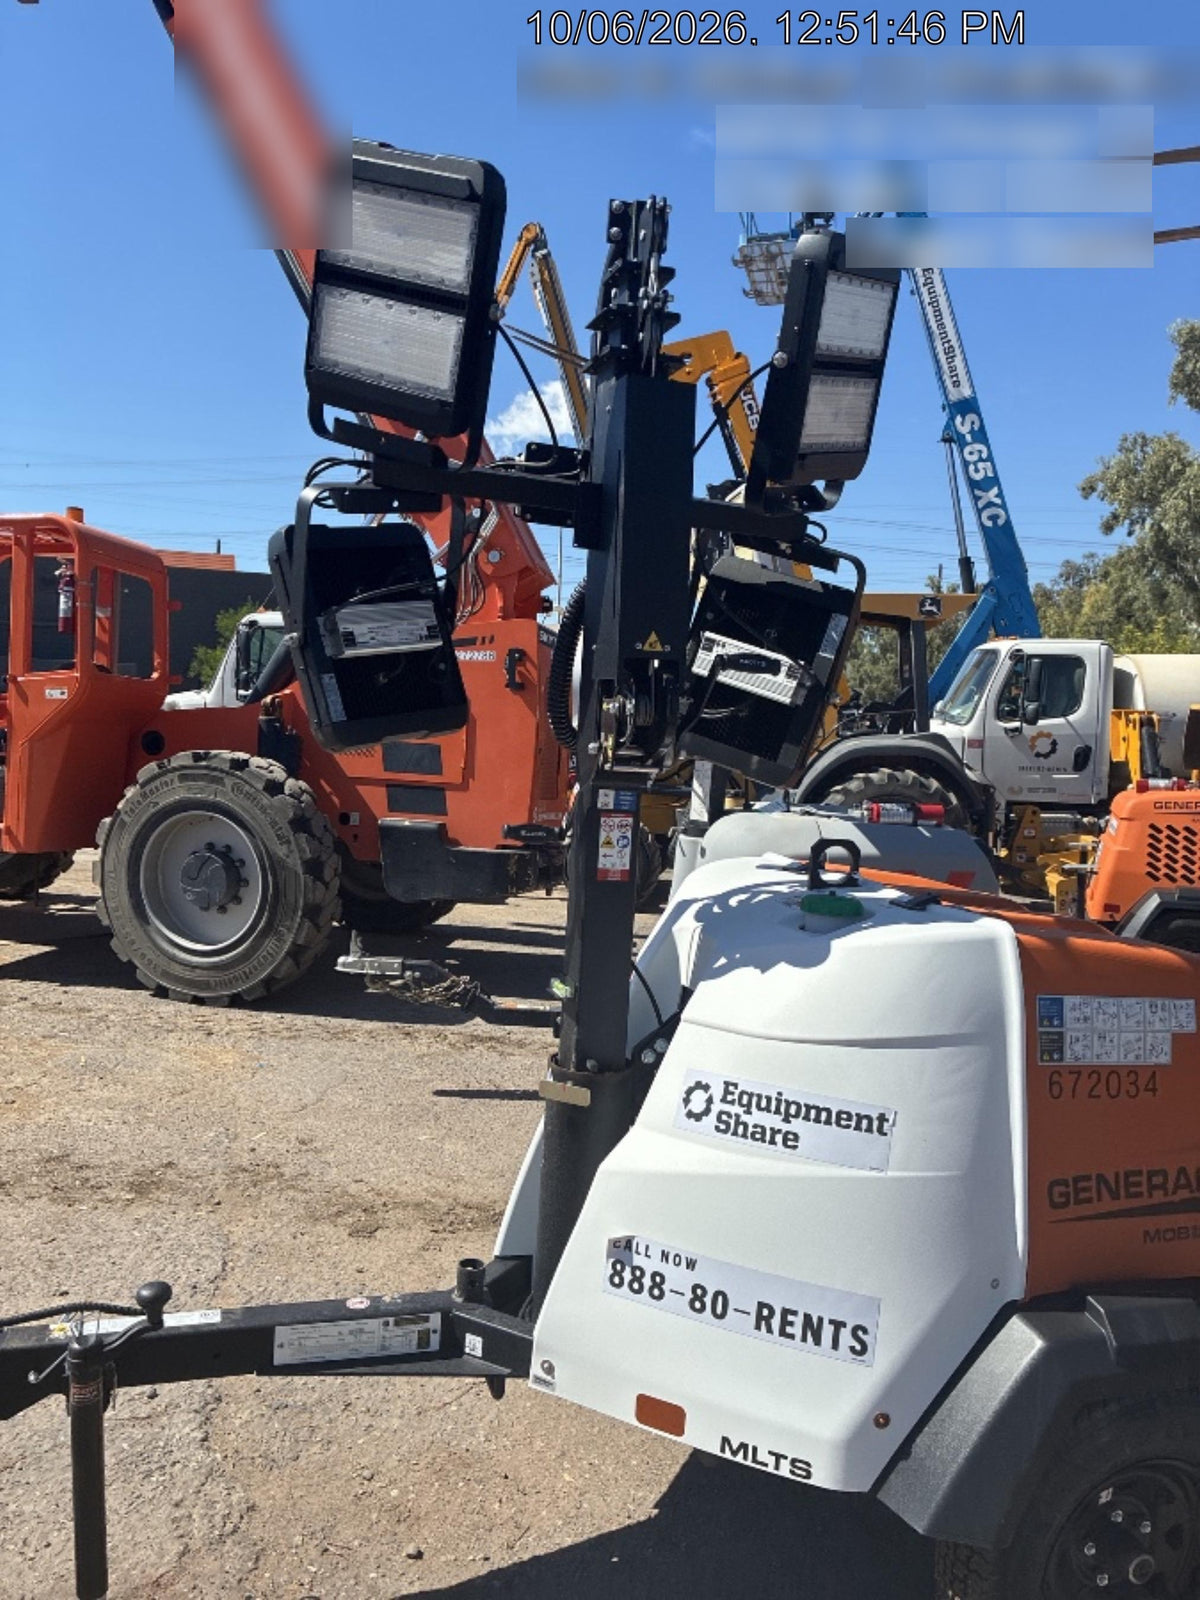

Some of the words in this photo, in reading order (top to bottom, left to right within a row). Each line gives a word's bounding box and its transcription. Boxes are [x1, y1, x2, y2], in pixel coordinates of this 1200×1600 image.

[922, 268, 961, 388] EquipmentShare
[740, 391, 760, 429] JCB
[954, 413, 994, 481] S-65
[973, 486, 1006, 527] XC
[1049, 1070, 1158, 1099] 672034
[720, 1081, 890, 1137] Equipment
[714, 1110, 800, 1151] Share
[1047, 1165, 1200, 1210] GENERA
[612, 1238, 652, 1259] CALL
[660, 1249, 698, 1272] NOW
[720, 1436, 813, 1480] MLTS
